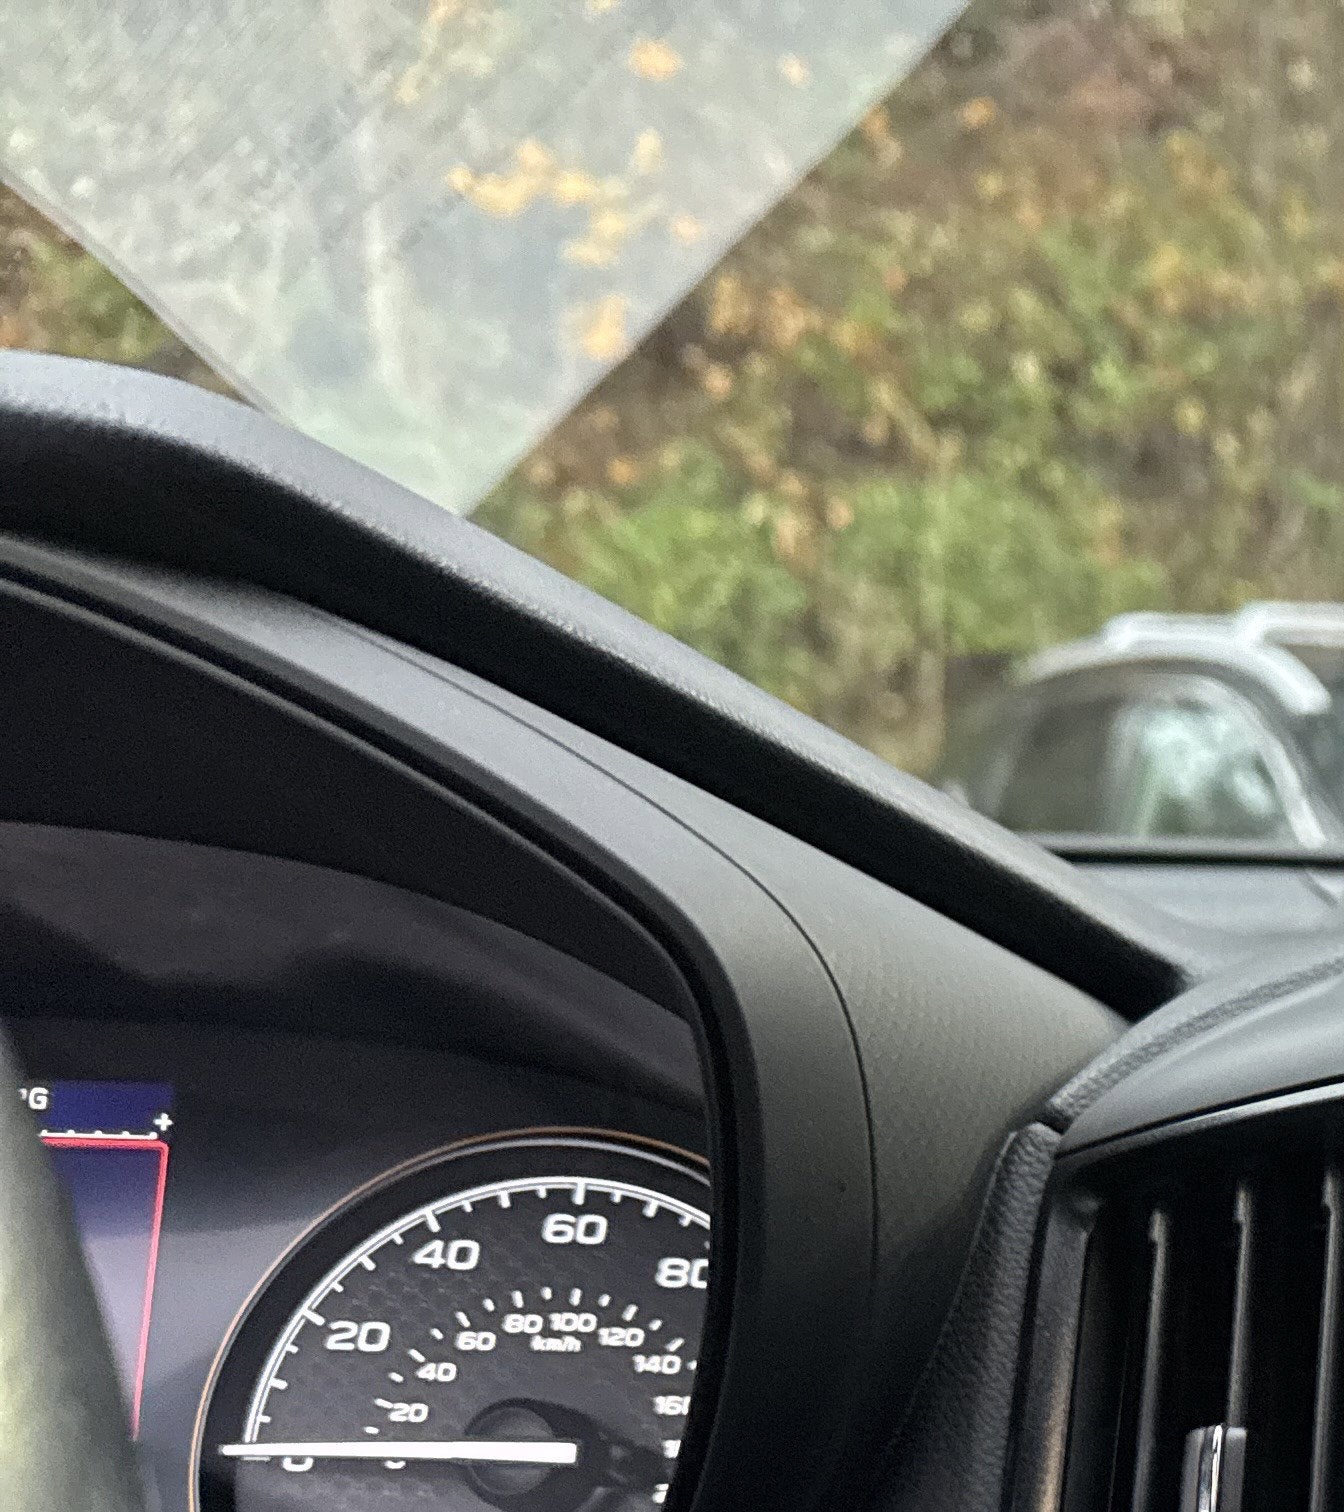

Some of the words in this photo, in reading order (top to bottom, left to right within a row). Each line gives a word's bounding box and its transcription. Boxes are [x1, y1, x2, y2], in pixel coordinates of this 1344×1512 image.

[542, 1213, 608, 1245] 60
[412, 1240, 480, 1270] 40
[503, 1313, 543, 1334] 80
[549, 1312, 598, 1333] 100
[326, 1320, 389, 1353] 20
[455, 1331, 496, 1351] 60
[531, 1335, 581, 1352] km/h
[598, 1327, 645, 1347] 120
[416, 1362, 457, 1382] 40
[632, 1354, 682, 1375] 140
[389, 1402, 428, 1423] 20
